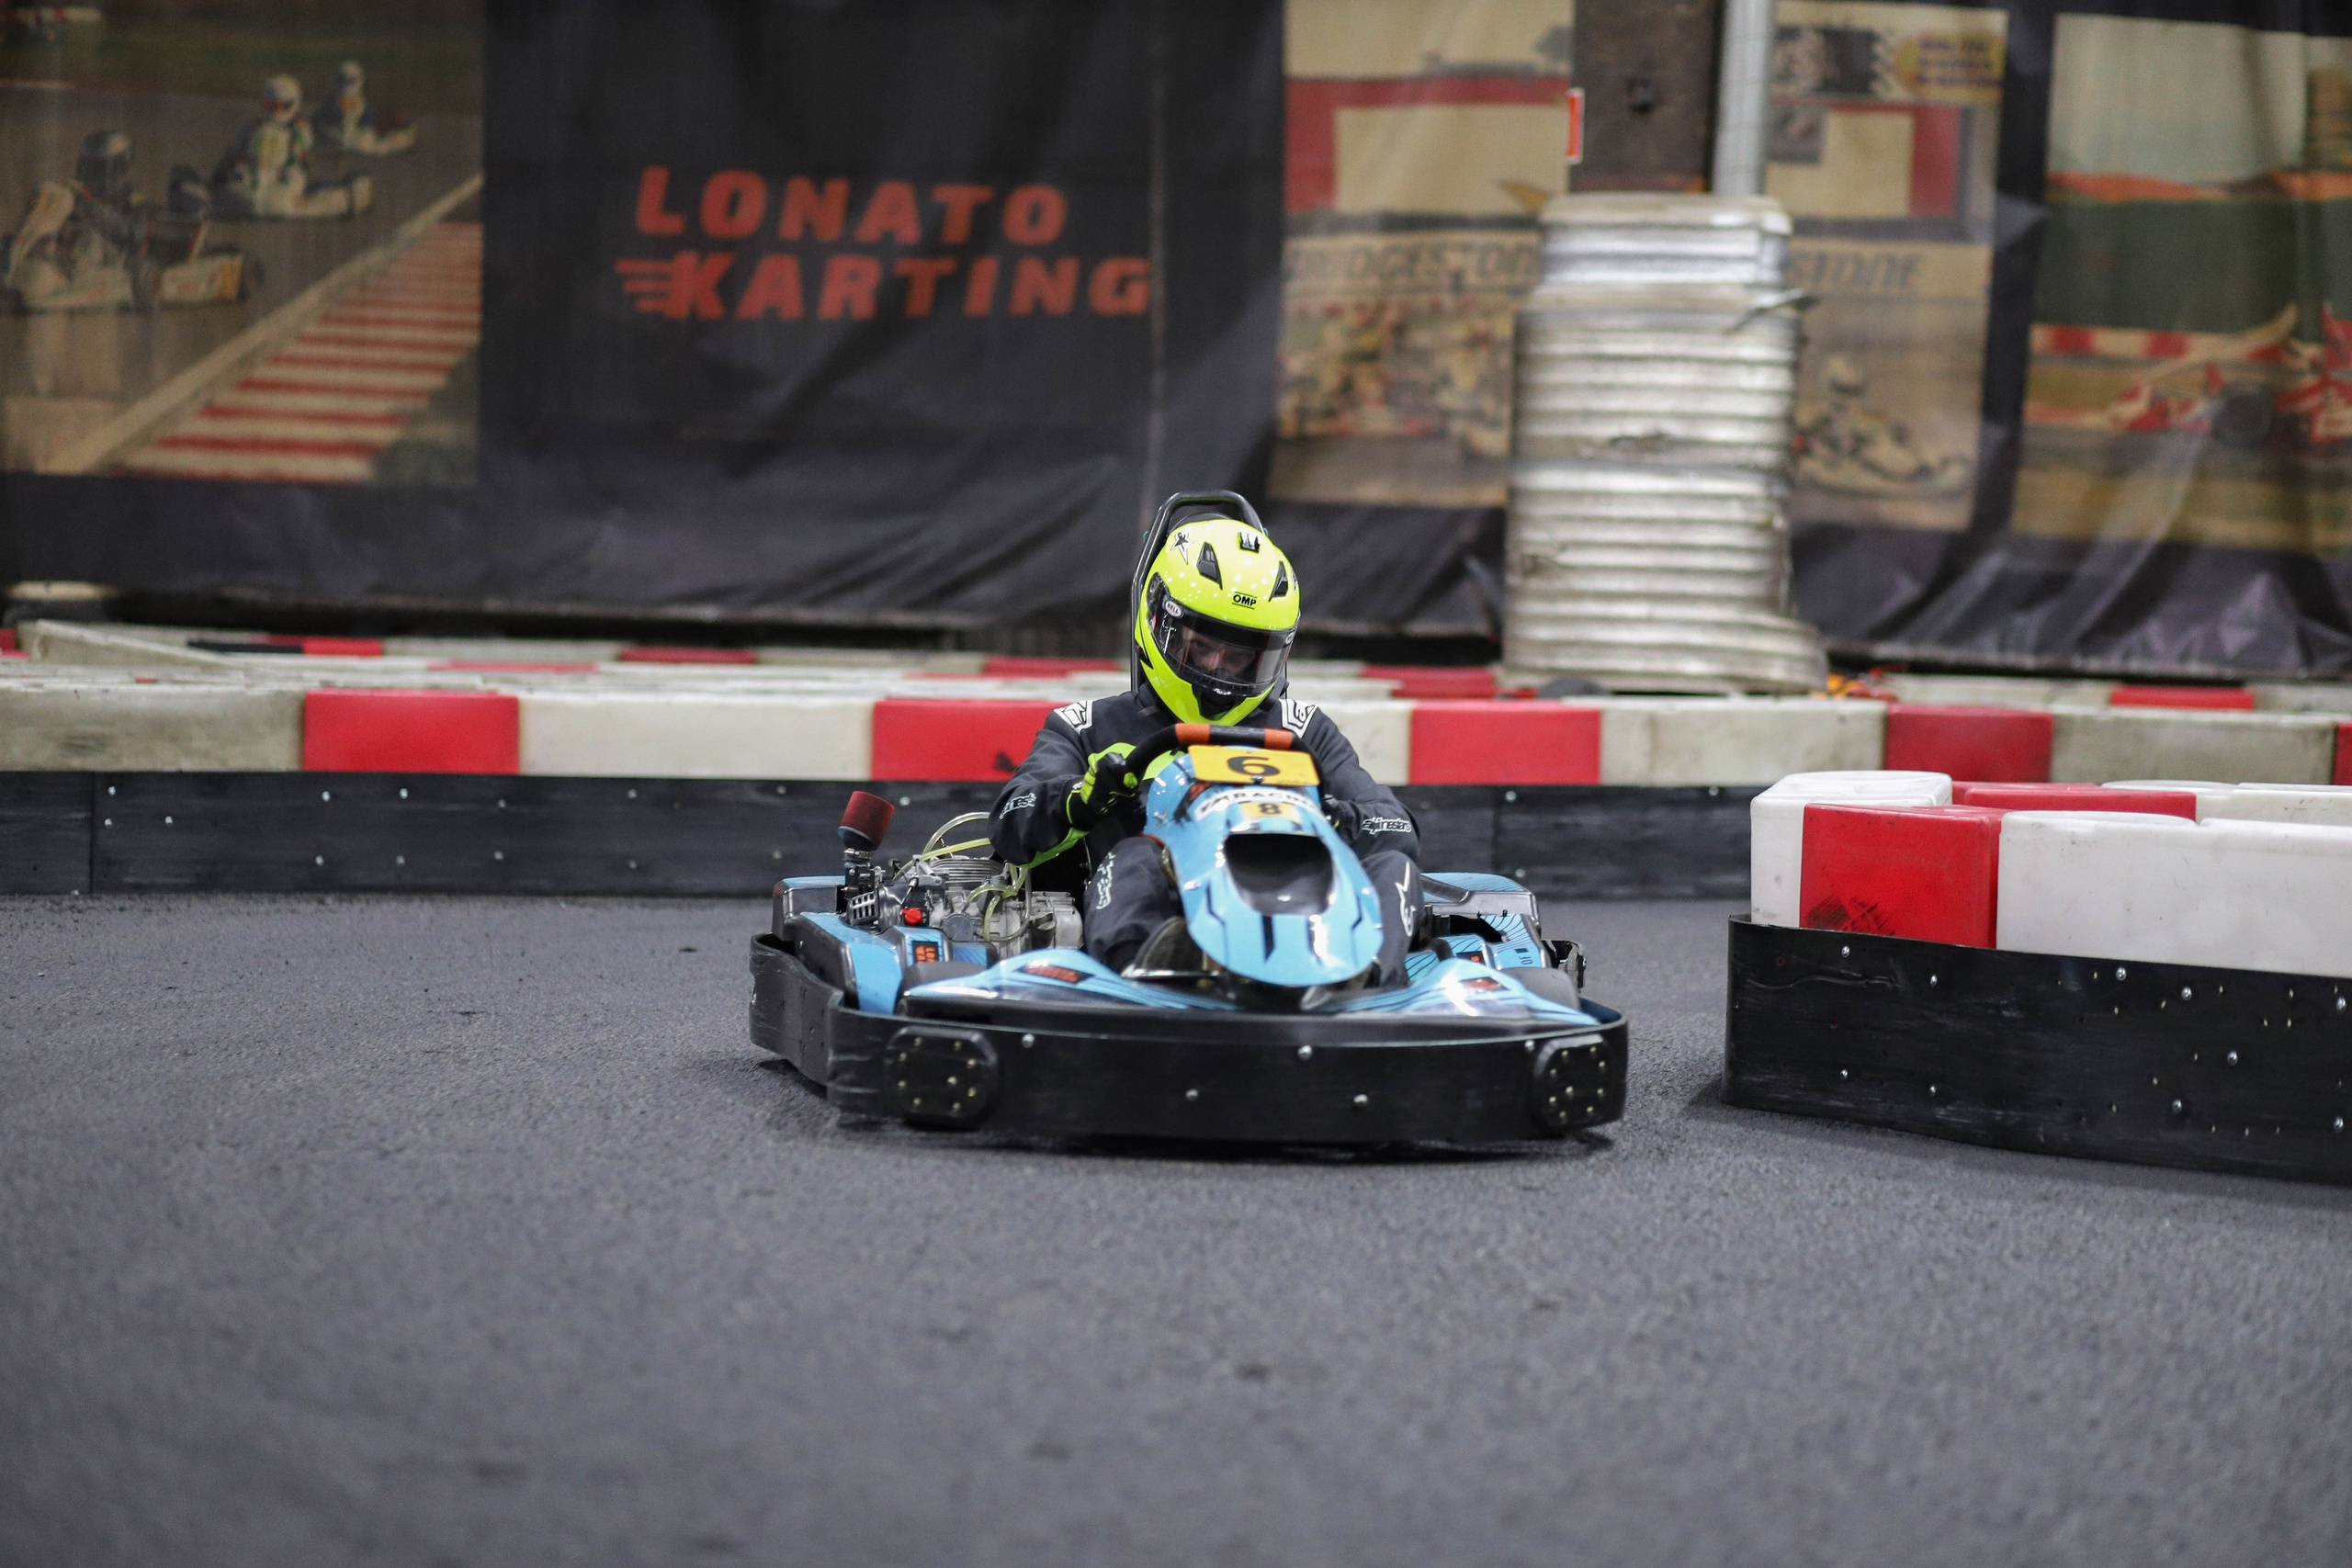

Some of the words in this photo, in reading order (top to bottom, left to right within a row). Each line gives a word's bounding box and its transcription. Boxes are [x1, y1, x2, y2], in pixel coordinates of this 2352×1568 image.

[635, 165, 1068, 246] LONATO
[616, 250, 1152, 321] KARTING
[1233, 594, 1257, 606] OMP
[1227, 756, 1281, 777] 6
[1259, 803, 1282, 816] 8
